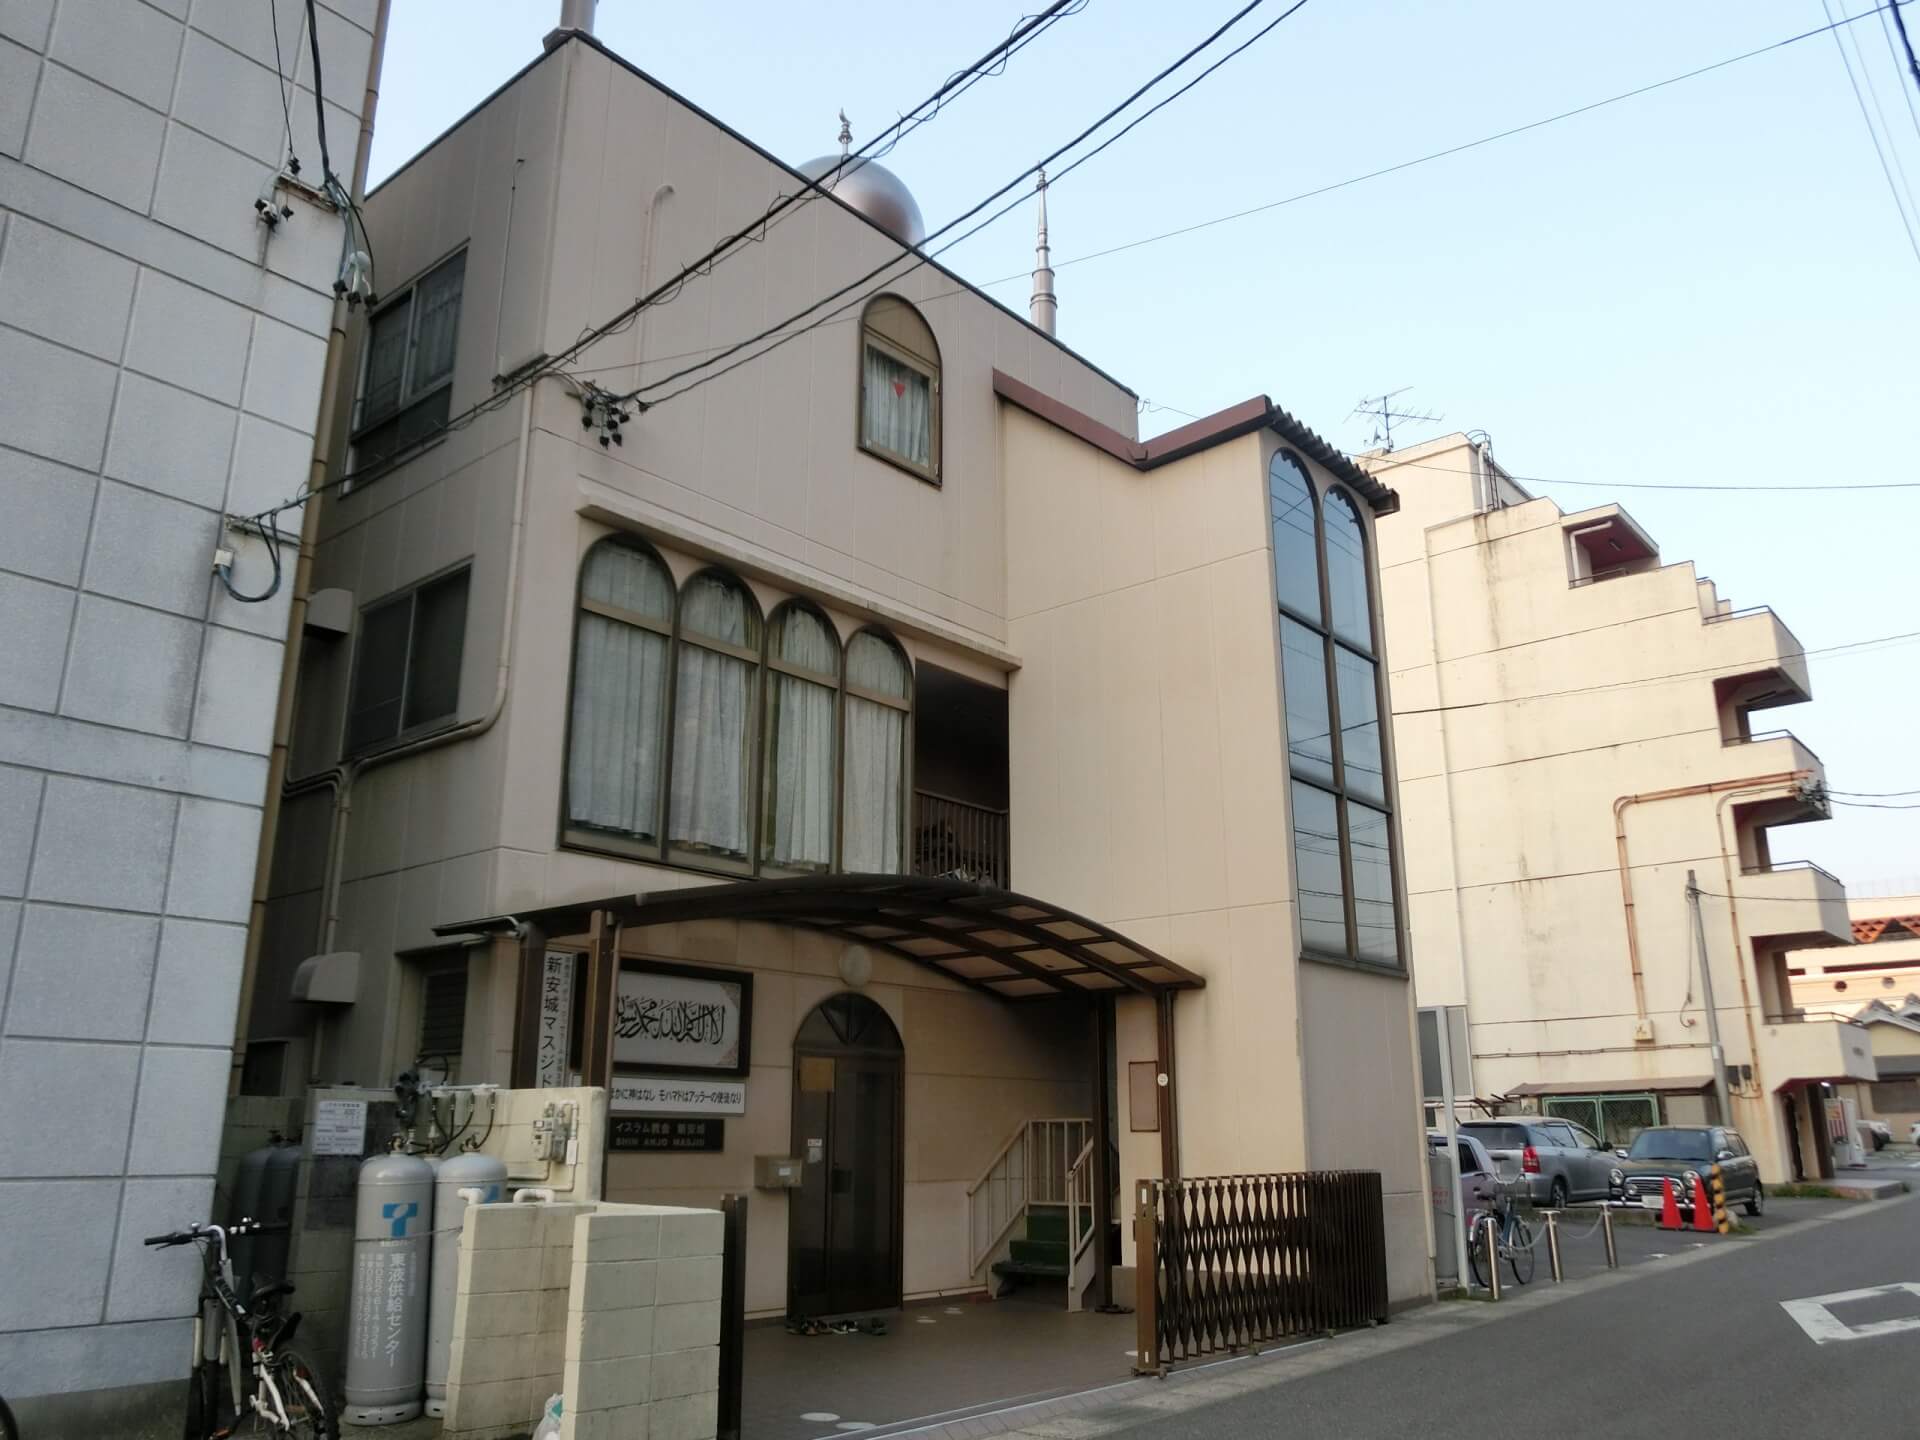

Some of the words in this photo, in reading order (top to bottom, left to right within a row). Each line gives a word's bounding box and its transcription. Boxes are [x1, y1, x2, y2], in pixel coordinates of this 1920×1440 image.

[540, 956, 562, 1087] 新安城マスジド
